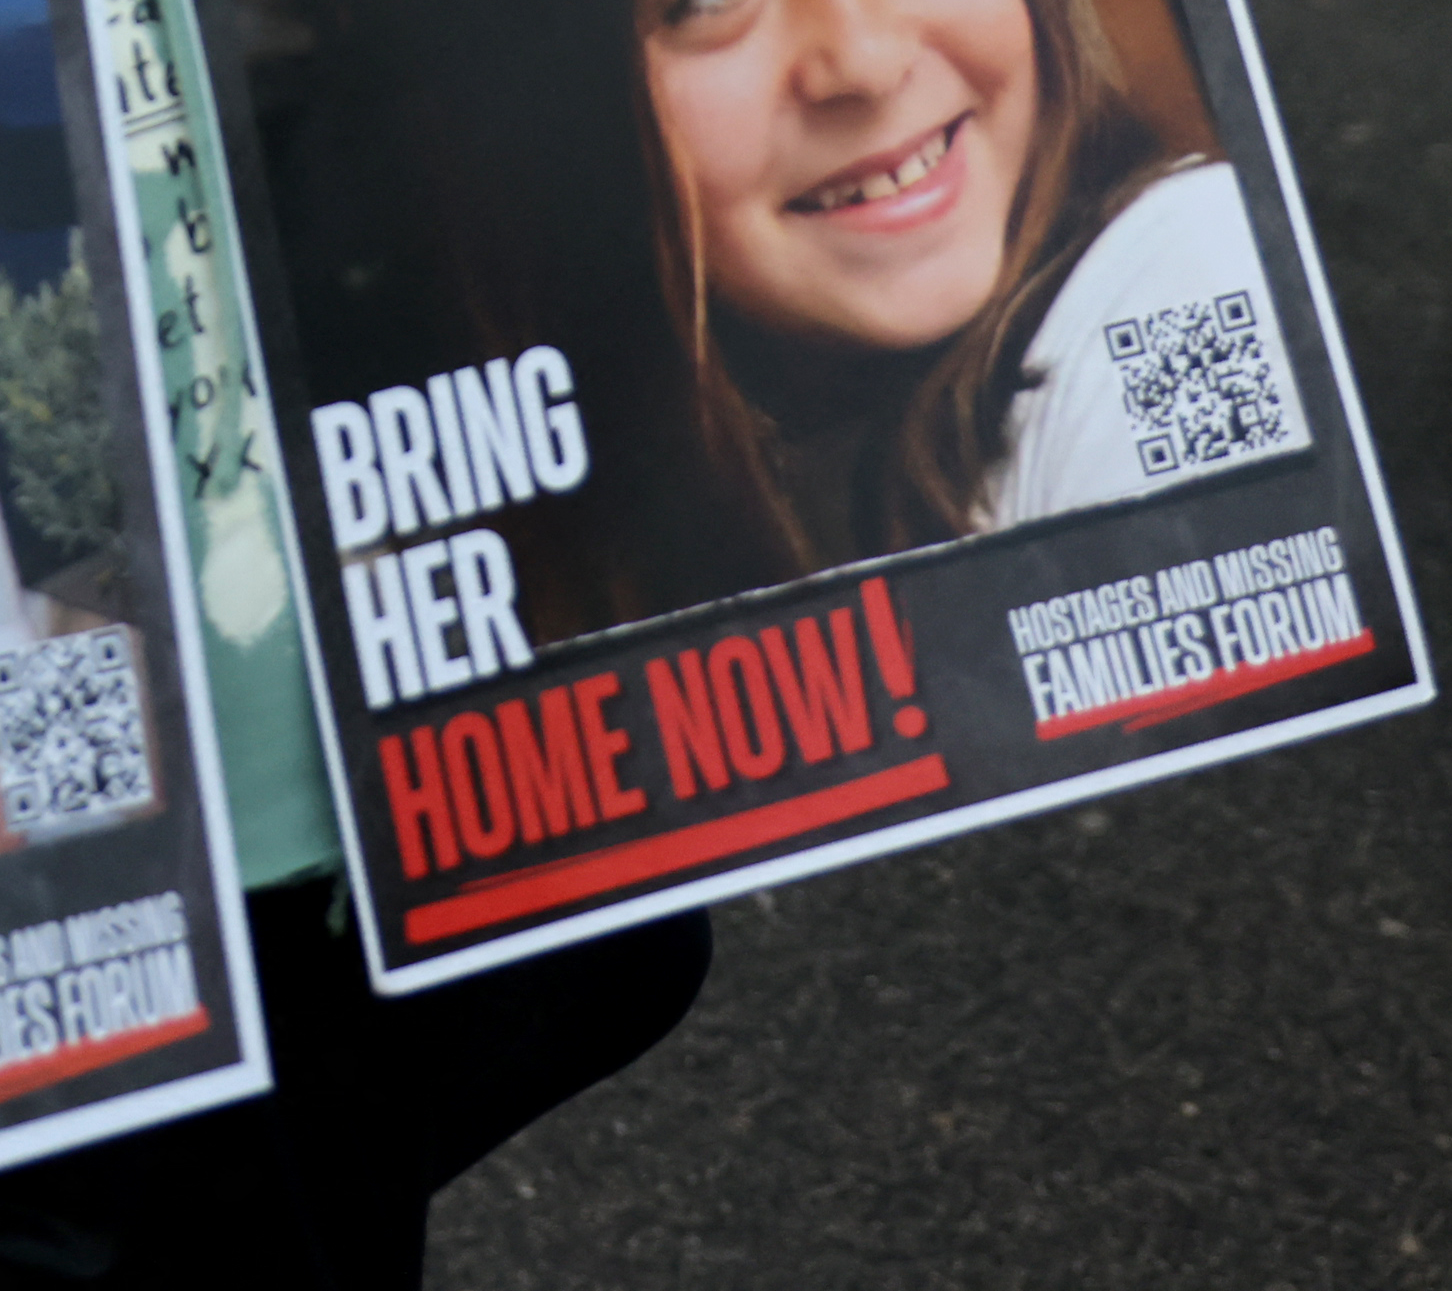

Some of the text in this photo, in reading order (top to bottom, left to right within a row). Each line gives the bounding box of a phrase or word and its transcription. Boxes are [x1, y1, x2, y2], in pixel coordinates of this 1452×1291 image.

[310, 344, 590, 551] BRING
[342, 527, 536, 711] HER
[1007, 525, 1345, 657] HOSTAGES AND MISSING
[1022, 572, 1363, 723] FAMILIES FORUM
[379, 575, 928, 881] HOME NOW!
[57, 940, 200, 1048] FORUM
